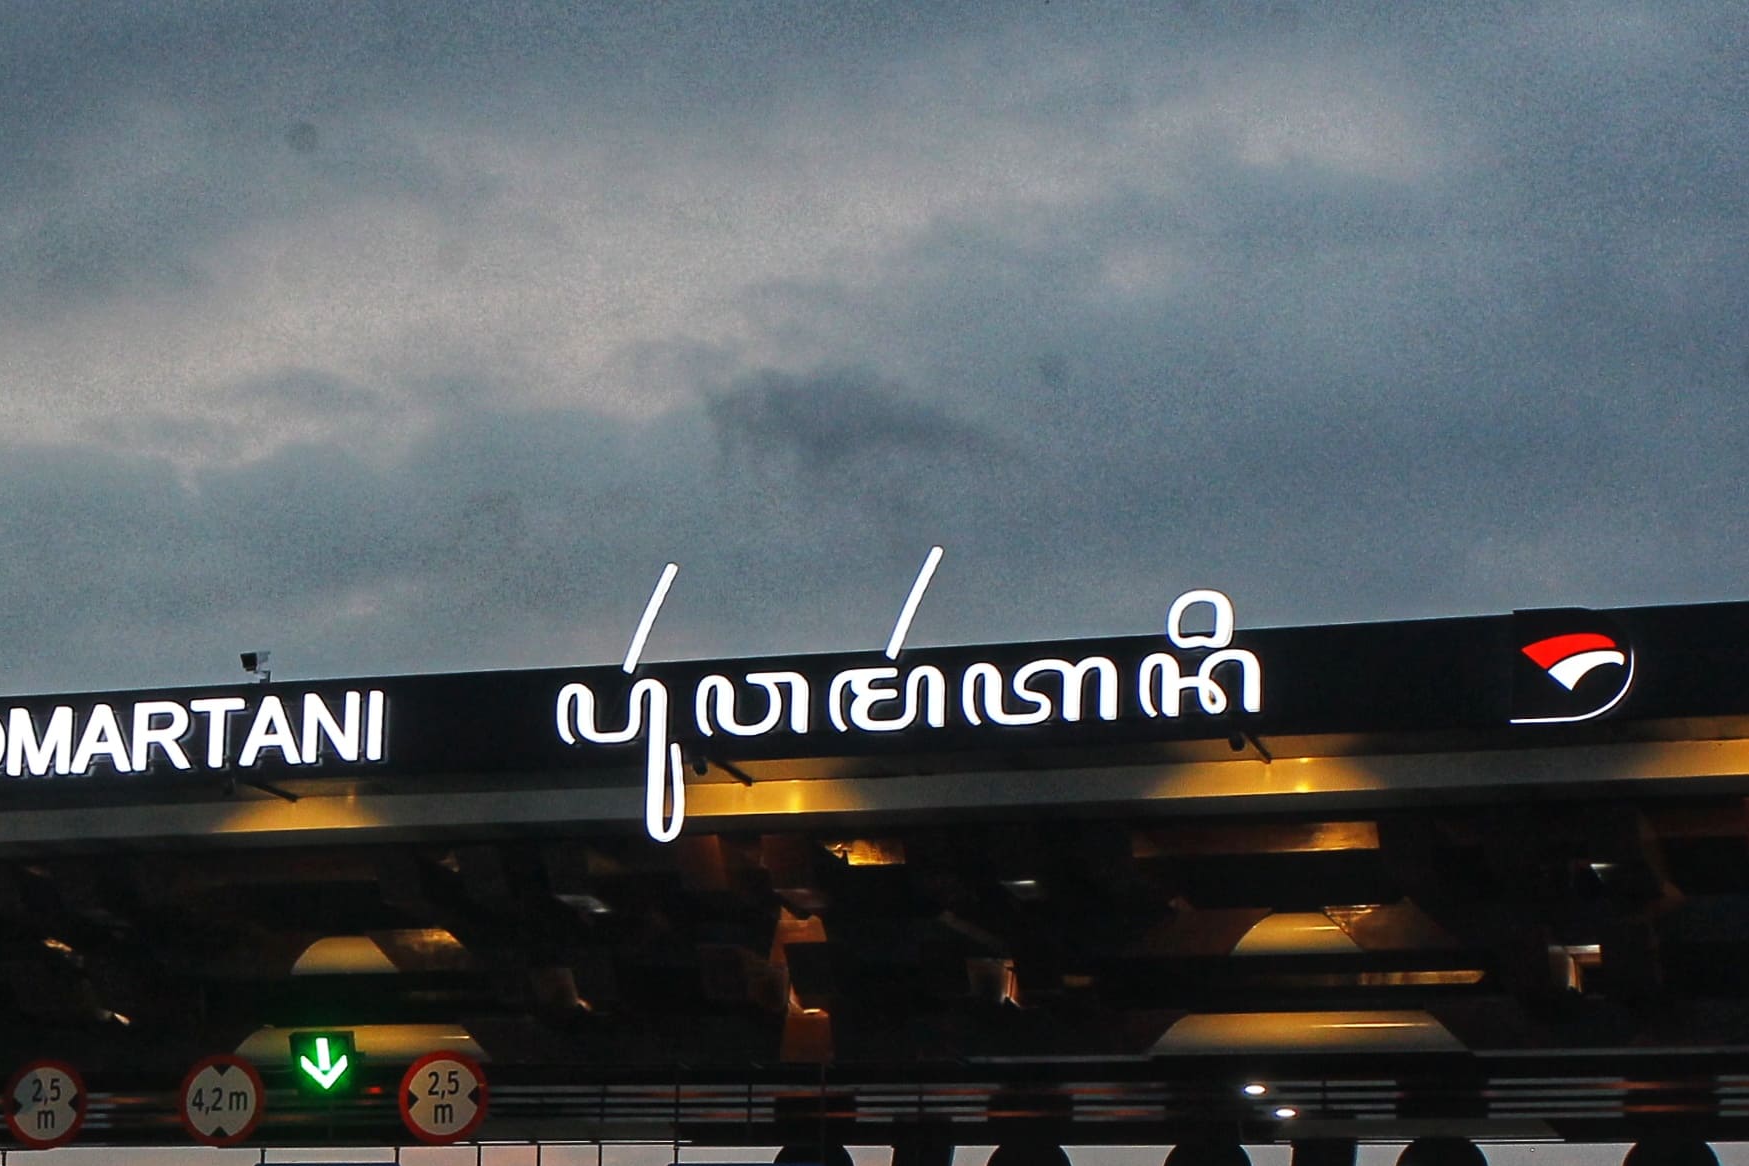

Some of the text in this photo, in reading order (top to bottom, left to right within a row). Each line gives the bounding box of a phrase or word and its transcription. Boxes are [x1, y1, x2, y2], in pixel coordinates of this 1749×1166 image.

[31, 1078, 62, 1106] 2,5
[427, 1072, 459, 1100] 2,5
[192, 1088, 249, 1113] 4,2 m
[36, 1109, 56, 1130] m
[433, 1103, 454, 1124] m
